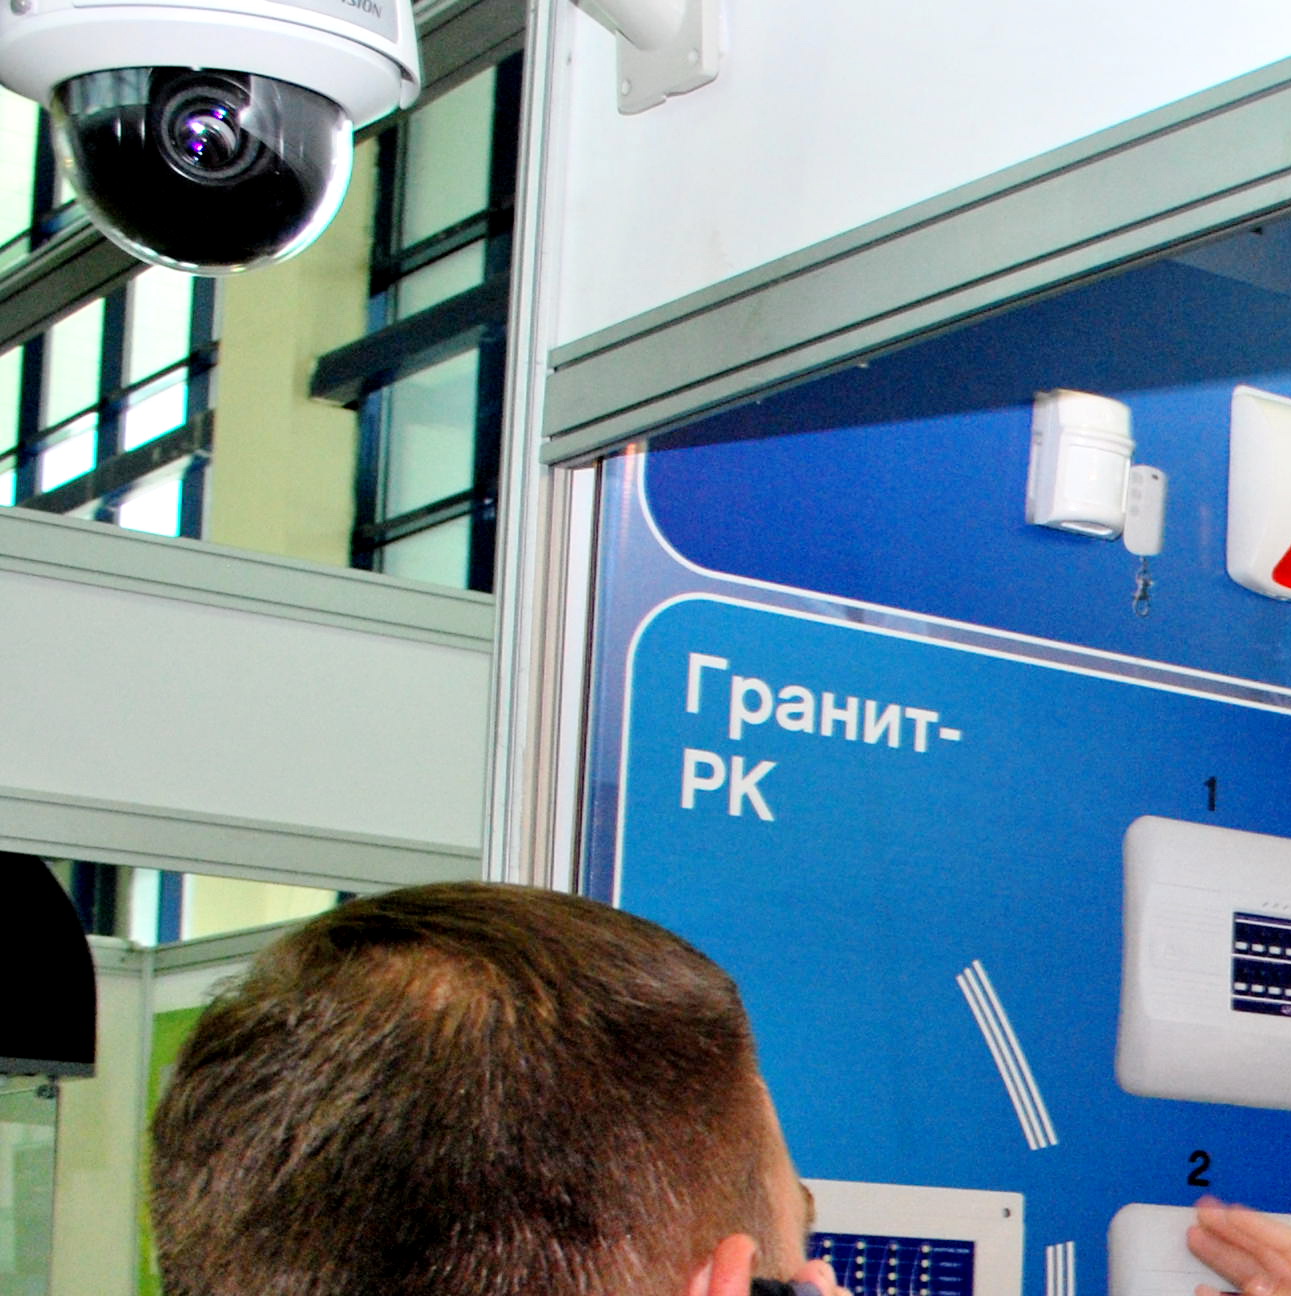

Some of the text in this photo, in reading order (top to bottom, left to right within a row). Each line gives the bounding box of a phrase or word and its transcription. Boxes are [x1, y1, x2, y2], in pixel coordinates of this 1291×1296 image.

[686, 652, 962, 753] Гранит-
[681, 748, 777, 822] РК
[1203, 776, 1216, 812] 1
[1188, 1150, 1211, 1187] 2
